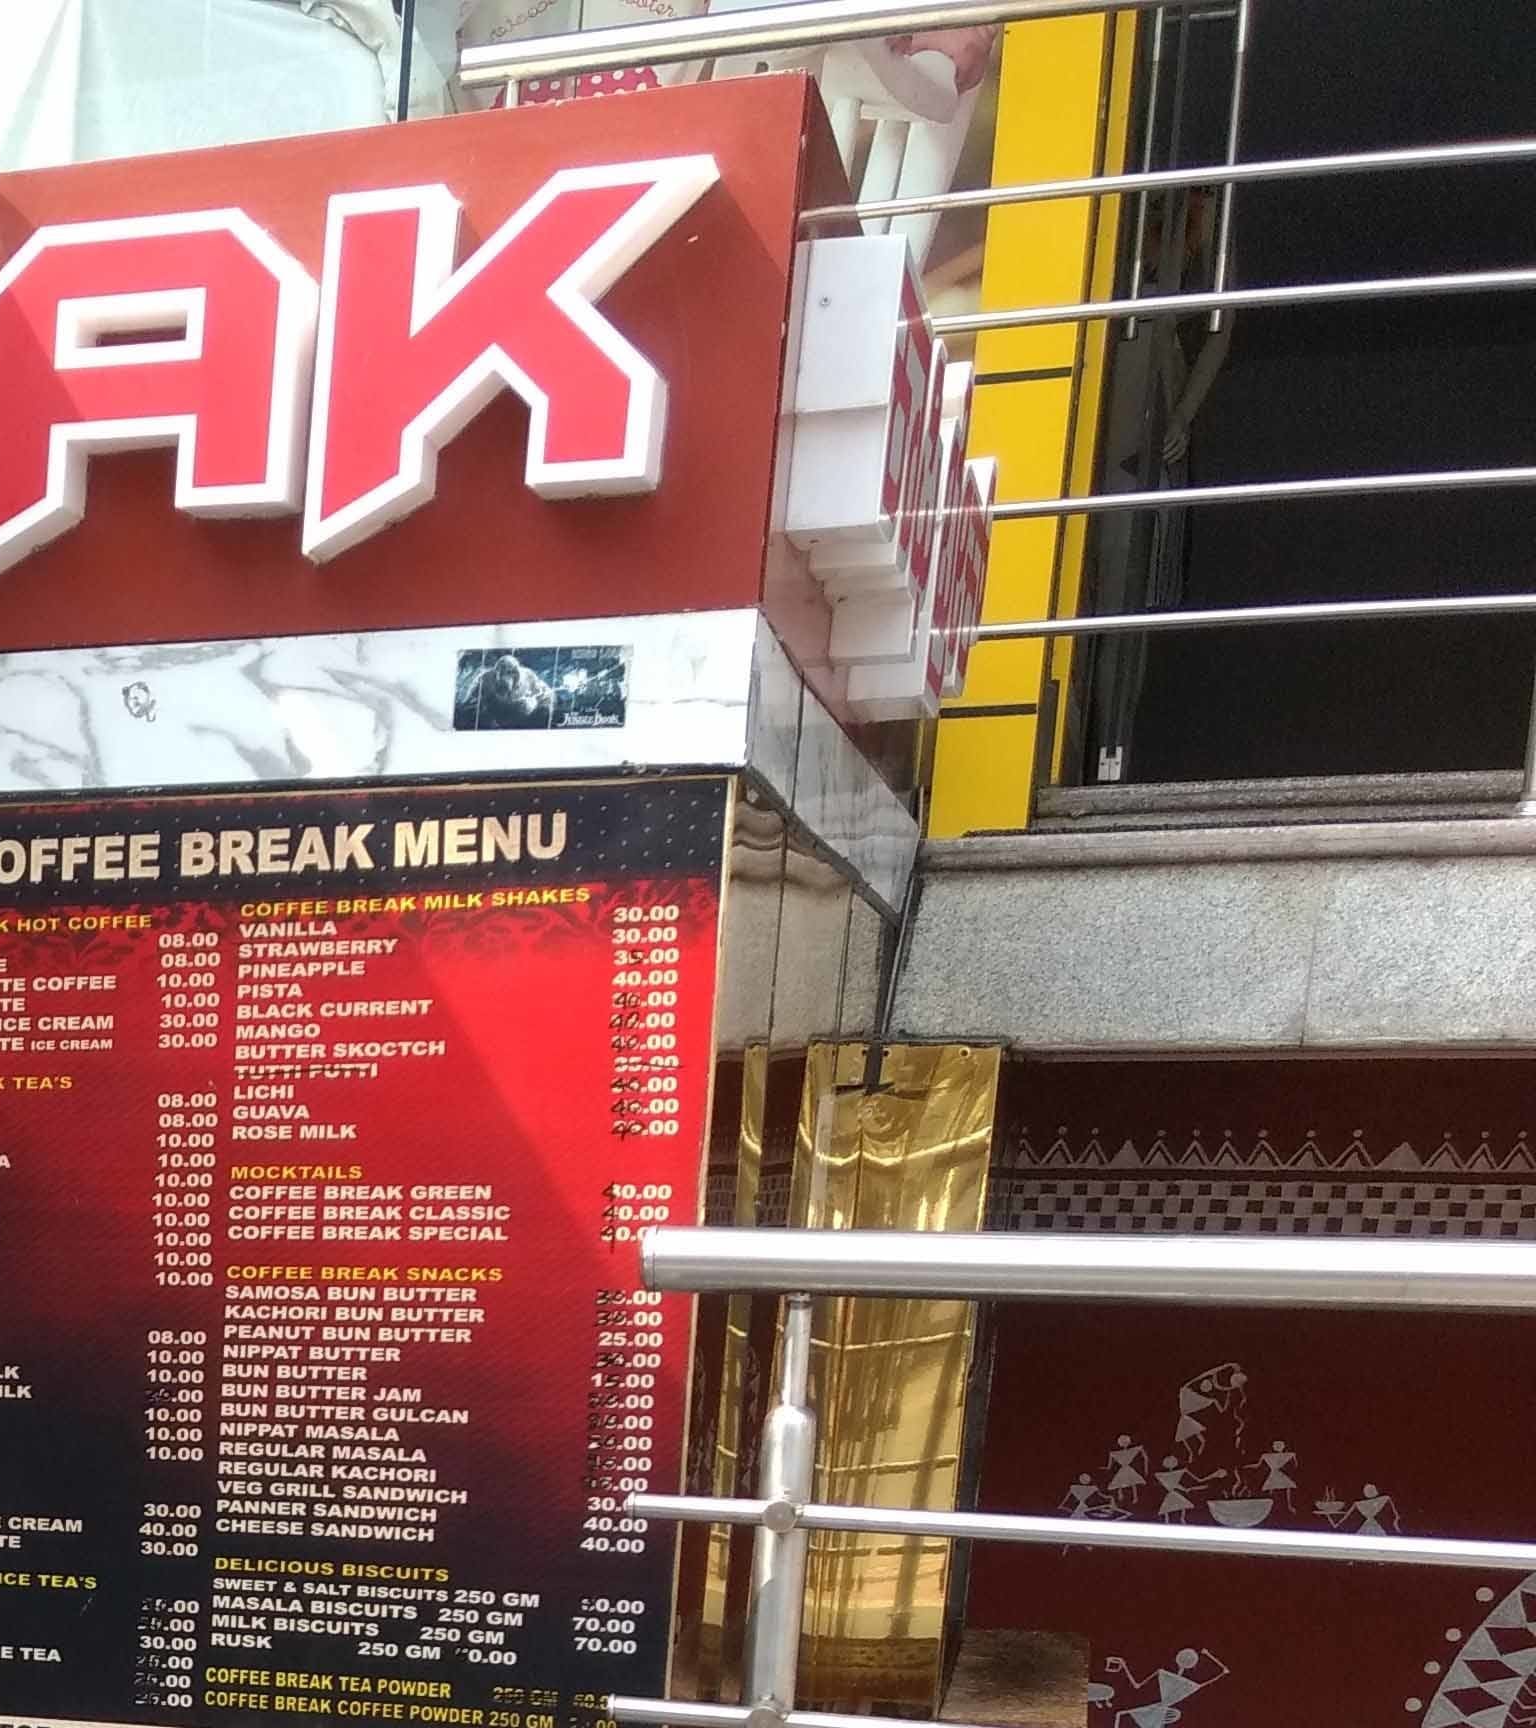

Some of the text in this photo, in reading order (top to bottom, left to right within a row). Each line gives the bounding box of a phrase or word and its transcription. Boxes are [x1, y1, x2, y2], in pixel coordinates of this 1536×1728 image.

[181, 822, 374, 877] BREAK
[394, 813, 566, 867] MENU
[241, 888, 589, 916] COFFEE BREAK MILK SHAKES
[18, 918, 60, 931] HOT
[69, 915, 151, 930] COFFEE
[240, 921, 337, 938] VANILLA
[159, 933, 218, 948] 08.00
[239, 927, 677, 958] STRAWBERRY 30.00
[33, 976, 116, 991] COFFEE
[157, 973, 214, 987] 10.00
[238, 984, 302, 998] PISTA
[237, 1000, 432, 1019] BLACK CURRENT
[38, 1016, 113, 1030] CREAM
[160, 1013, 218, 1028] 30.00
[236, 1041, 445, 1059] BUTTER SKOCTCH
[13, 1077, 72, 1089] TEA'S
[158, 1093, 216, 1107] 08.00
[234, 1085, 293, 1099] LICHI
[233, 1125, 356, 1139] ROSE MILK
[232, 1166, 361, 1179] MOCKTAILS
[230, 1186, 491, 1200] COFFEE BREAK GREEN
[229, 1206, 510, 1220] COFFEE BREAK CLASSIC
[227, 1266, 502, 1281] COFFEE BREAK SNACKS
[226, 1286, 476, 1302] SAMOSA BUN BUTTER
[224, 1345, 400, 1361] NIPPAT BUTTER
[222, 1384, 421, 1402] BUN BUTTER JAM
[221, 1403, 468, 1423] BUN BUTTER GULCAN
[144, 1504, 201, 1518] 30.00
[216, 1519, 434, 1541] CHEESE SANDWICH
[141, 1542, 198, 1556] 30.00
[215, 1558, 448, 1581] DELICIOUS BISCUITS
[38, 1575, 96, 1589] TEA'S
[214, 1578, 539, 1607] SWEET & SALT BISCUITS 250 GM
[213, 1595, 522, 1626] MASALA BISCUITS 250 GM
[212, 1633, 440, 1659] RUSK 250 GM
[20, 1648, 61, 1661] TEA
[206, 1668, 450, 1698] COFFEE BREAK TEA POWDER
